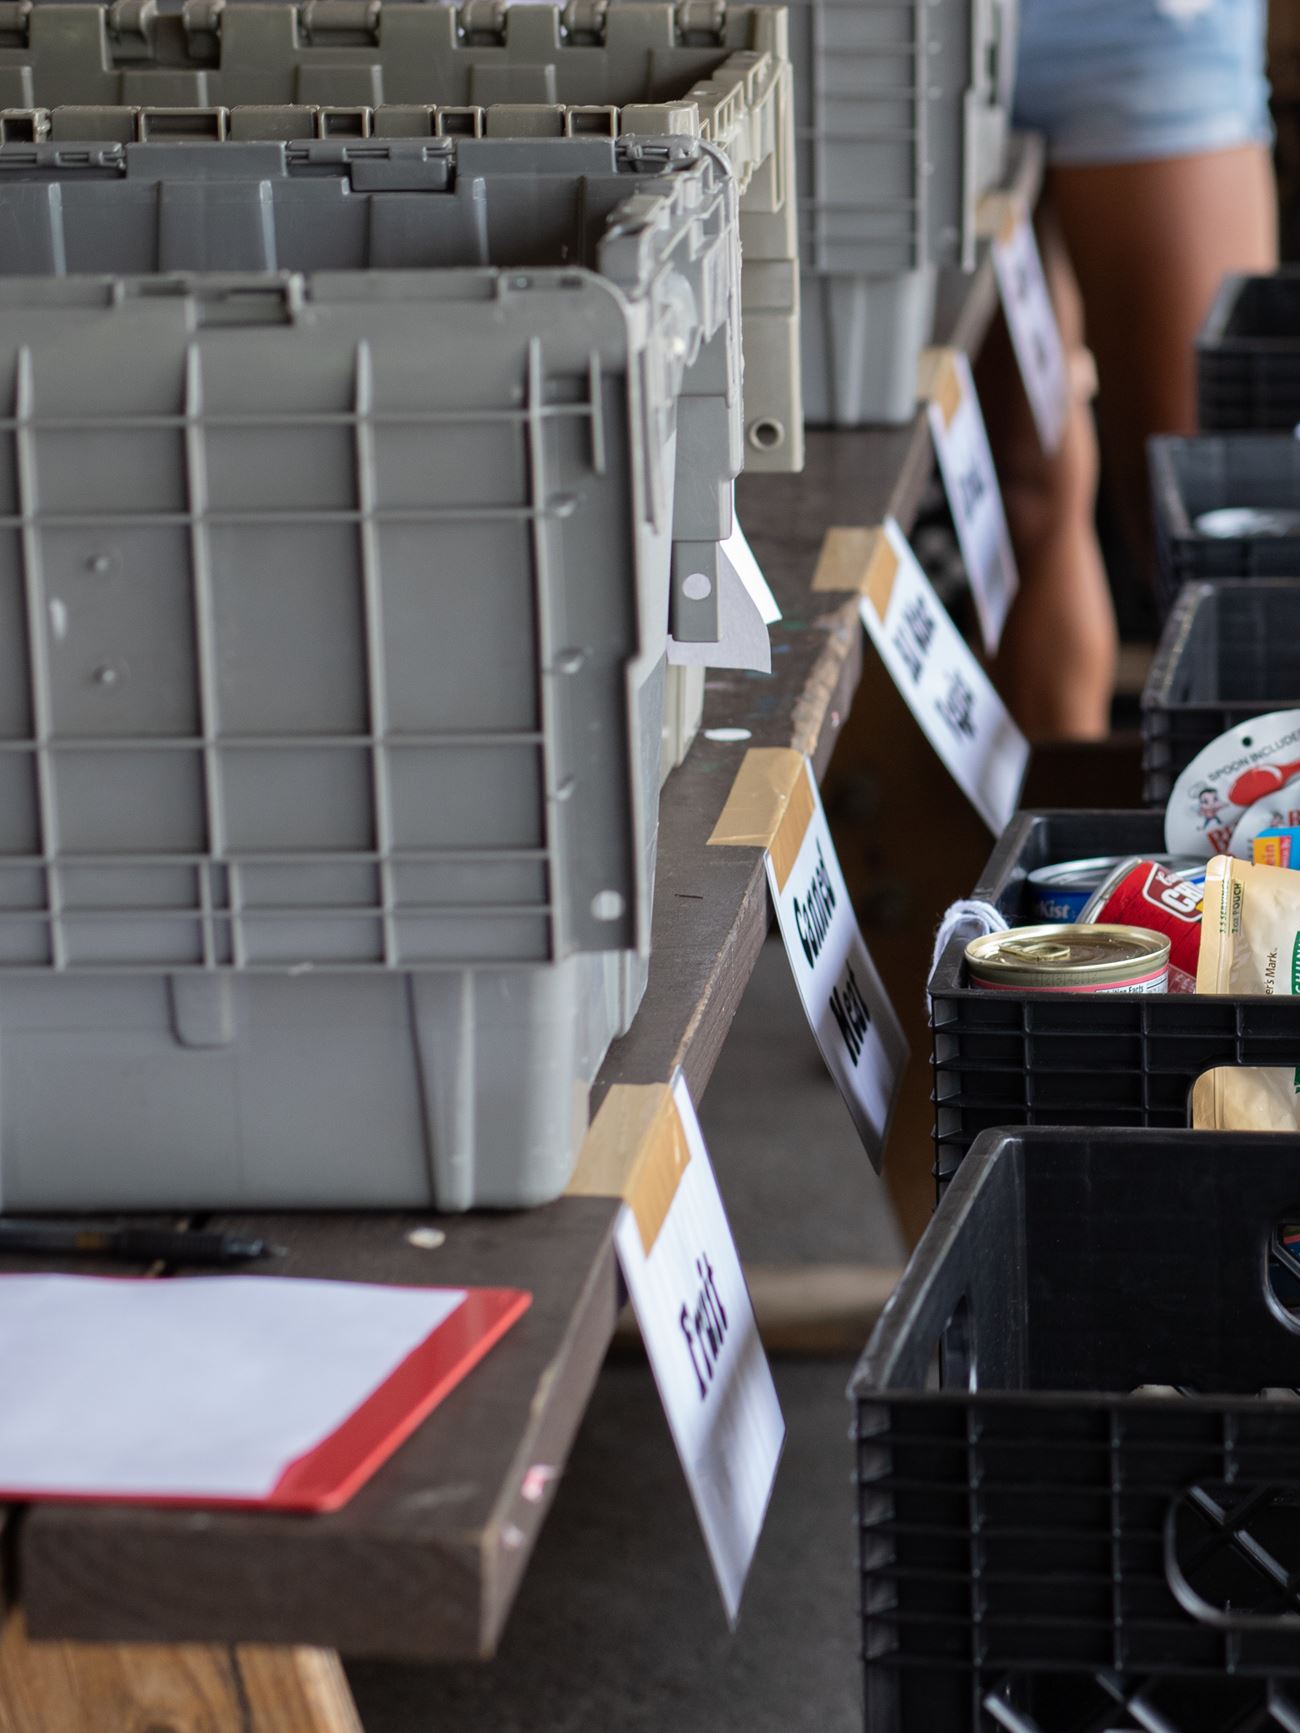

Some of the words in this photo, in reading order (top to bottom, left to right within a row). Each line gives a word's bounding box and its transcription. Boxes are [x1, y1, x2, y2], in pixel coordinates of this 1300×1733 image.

[1208, 756, 1250, 781] SPOON
[793, 838, 837, 971] Canned
[1231, 882, 1242, 916] POUCH
[1265, 951, 1278, 978] Mark
[829, 961, 871, 1069] Meat
[679, 1251, 728, 1402] Fruit
